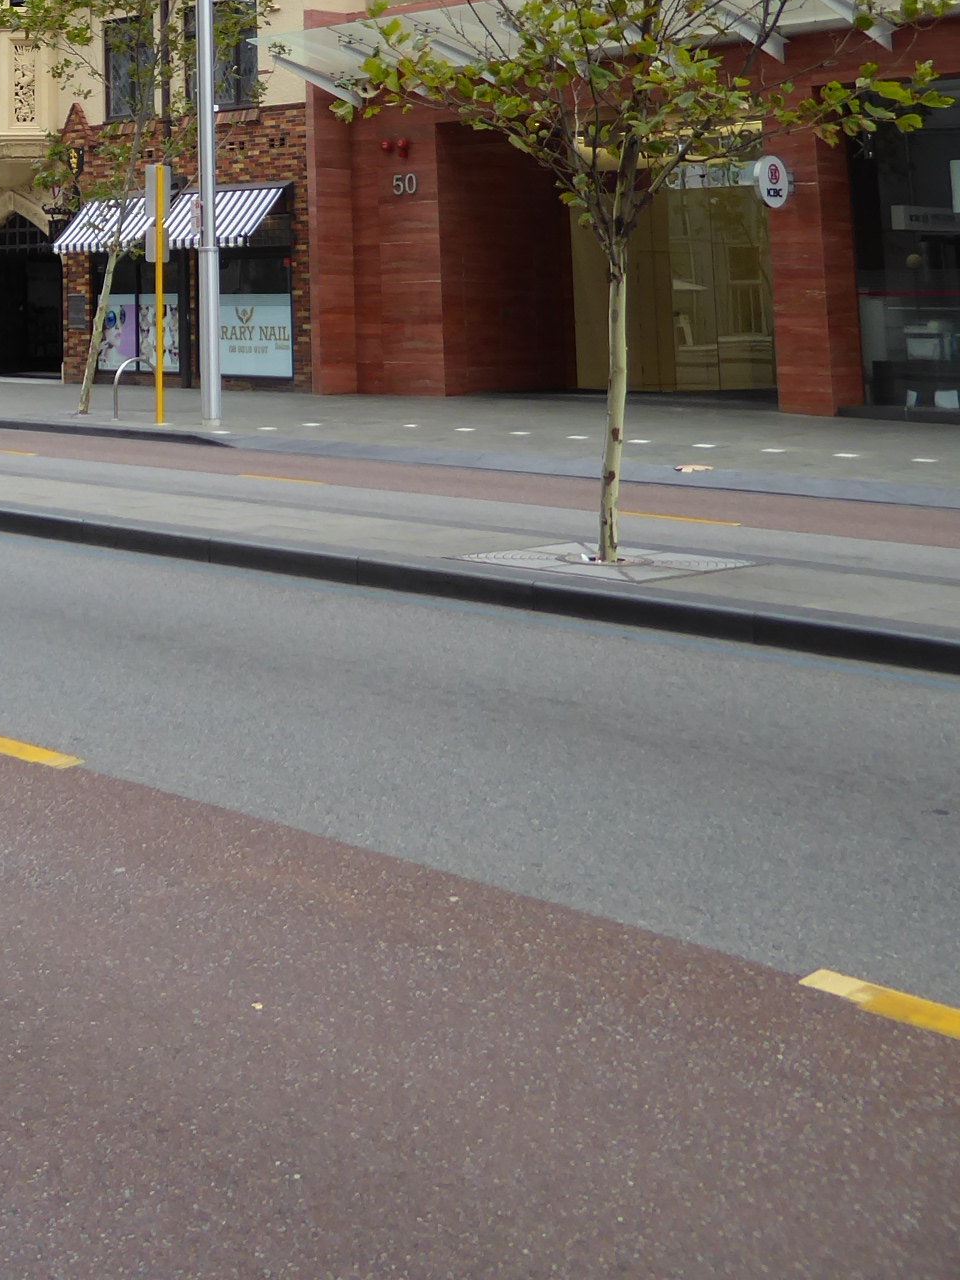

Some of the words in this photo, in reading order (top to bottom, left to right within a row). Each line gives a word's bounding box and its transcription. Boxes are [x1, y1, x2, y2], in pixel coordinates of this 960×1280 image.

[393, 173, 417, 195] 50
[766, 188, 782, 198] ICBC
[259, 326, 290, 341] NAIL
